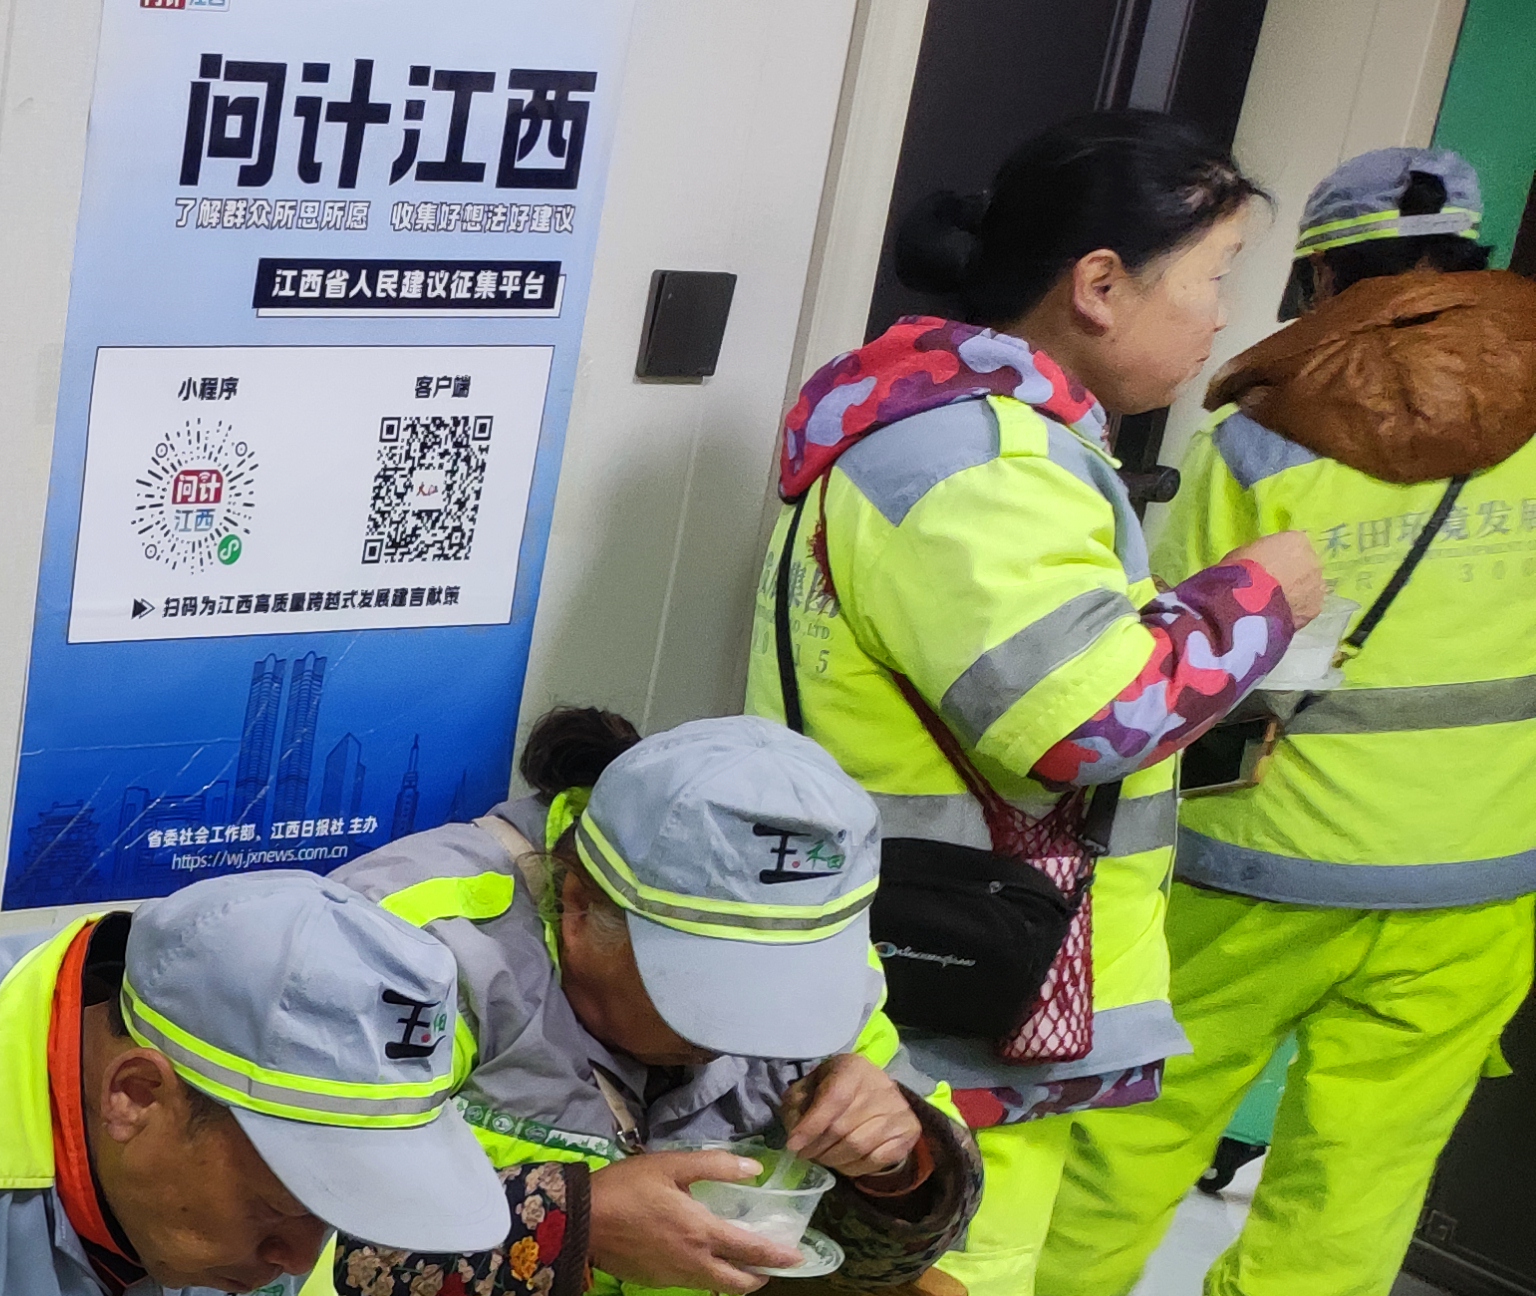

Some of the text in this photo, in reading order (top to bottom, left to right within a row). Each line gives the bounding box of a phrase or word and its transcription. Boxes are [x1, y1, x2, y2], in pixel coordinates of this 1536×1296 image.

[179, 53, 598, 190] 问计江西
[175, 197, 576, 233] 了解群众所思所愿 收集好想法好建议
[271, 268, 546, 300] 江西省人民建议征集平台
[177, 376, 240, 402] 小程序
[414, 374, 472, 399] 客户端
[176, 472, 222, 503] 问计
[174, 508, 216, 532] 江西
[162, 585, 461, 618] 扫码为江西高质量跨越式发展建言献策
[347, 815, 379, 835] 主办
[171, 845, 349, 873] https://wj.jxnews.com.cn
